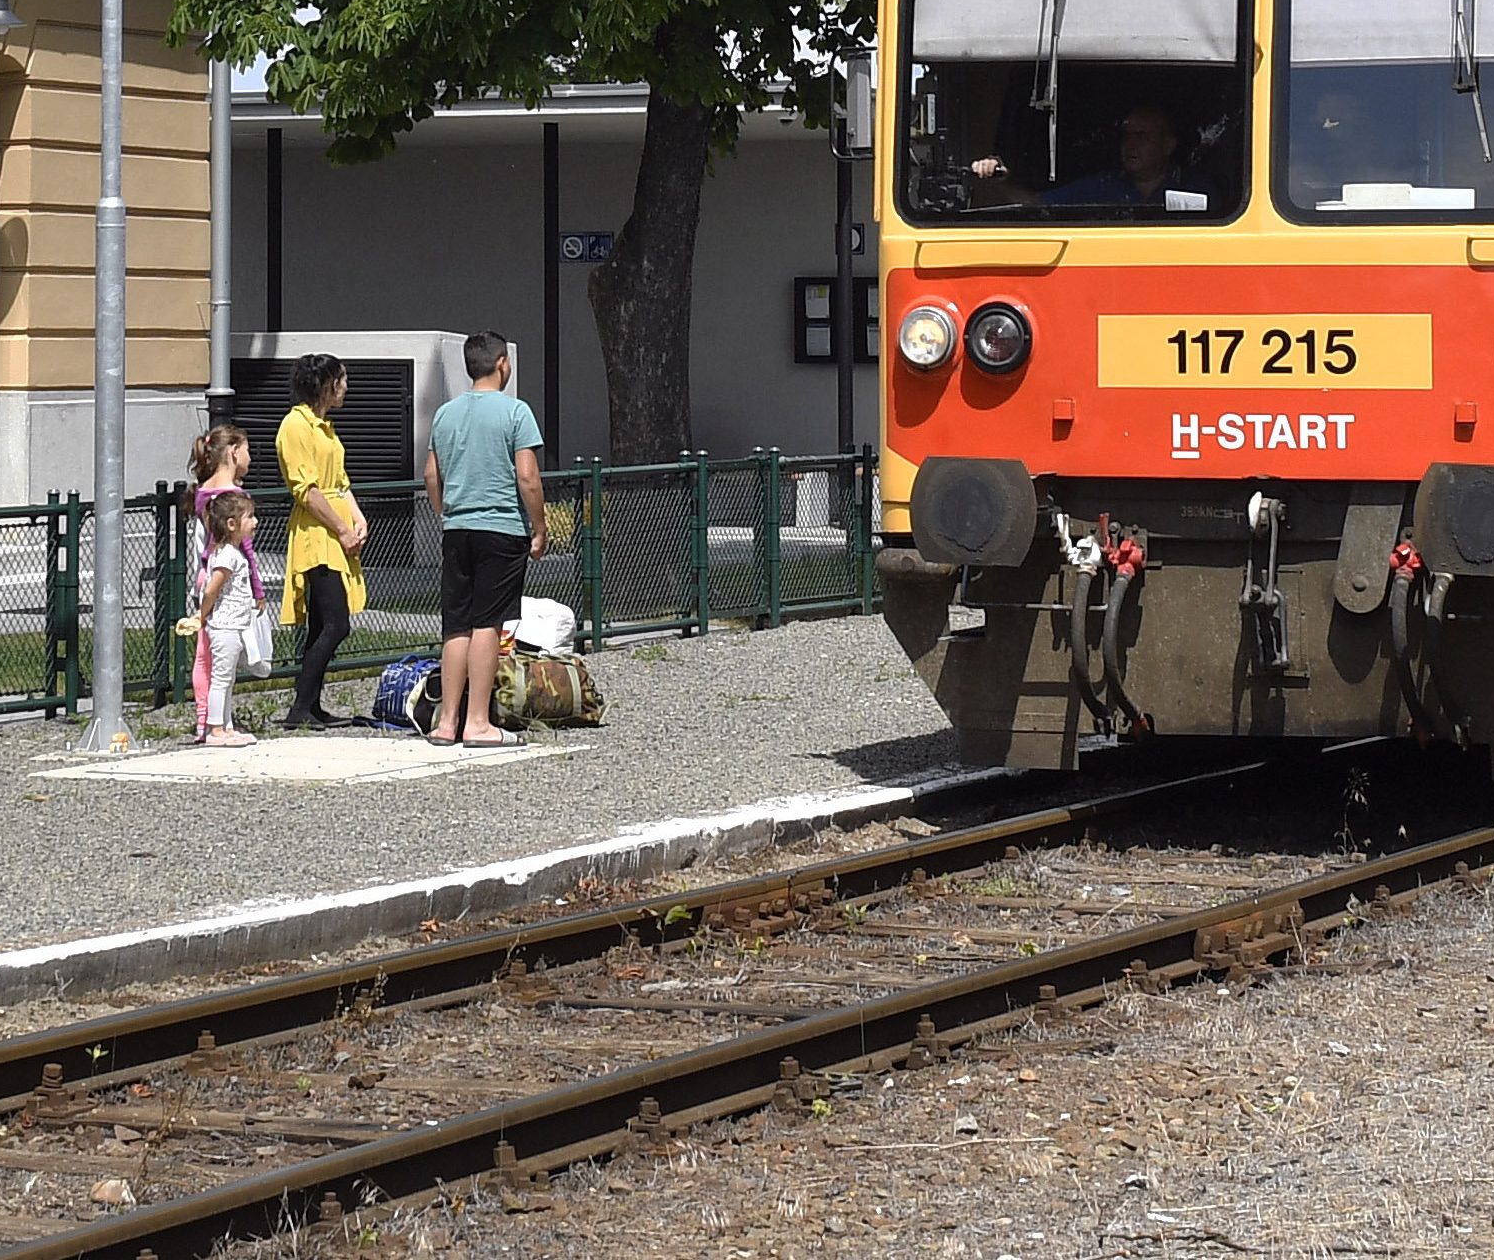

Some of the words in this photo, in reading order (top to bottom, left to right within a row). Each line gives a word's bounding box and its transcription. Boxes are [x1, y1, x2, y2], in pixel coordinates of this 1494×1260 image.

[1168, 329, 1244, 374] 117
[1262, 329, 1357, 375] 215
[1171, 413, 1355, 453] H-START
